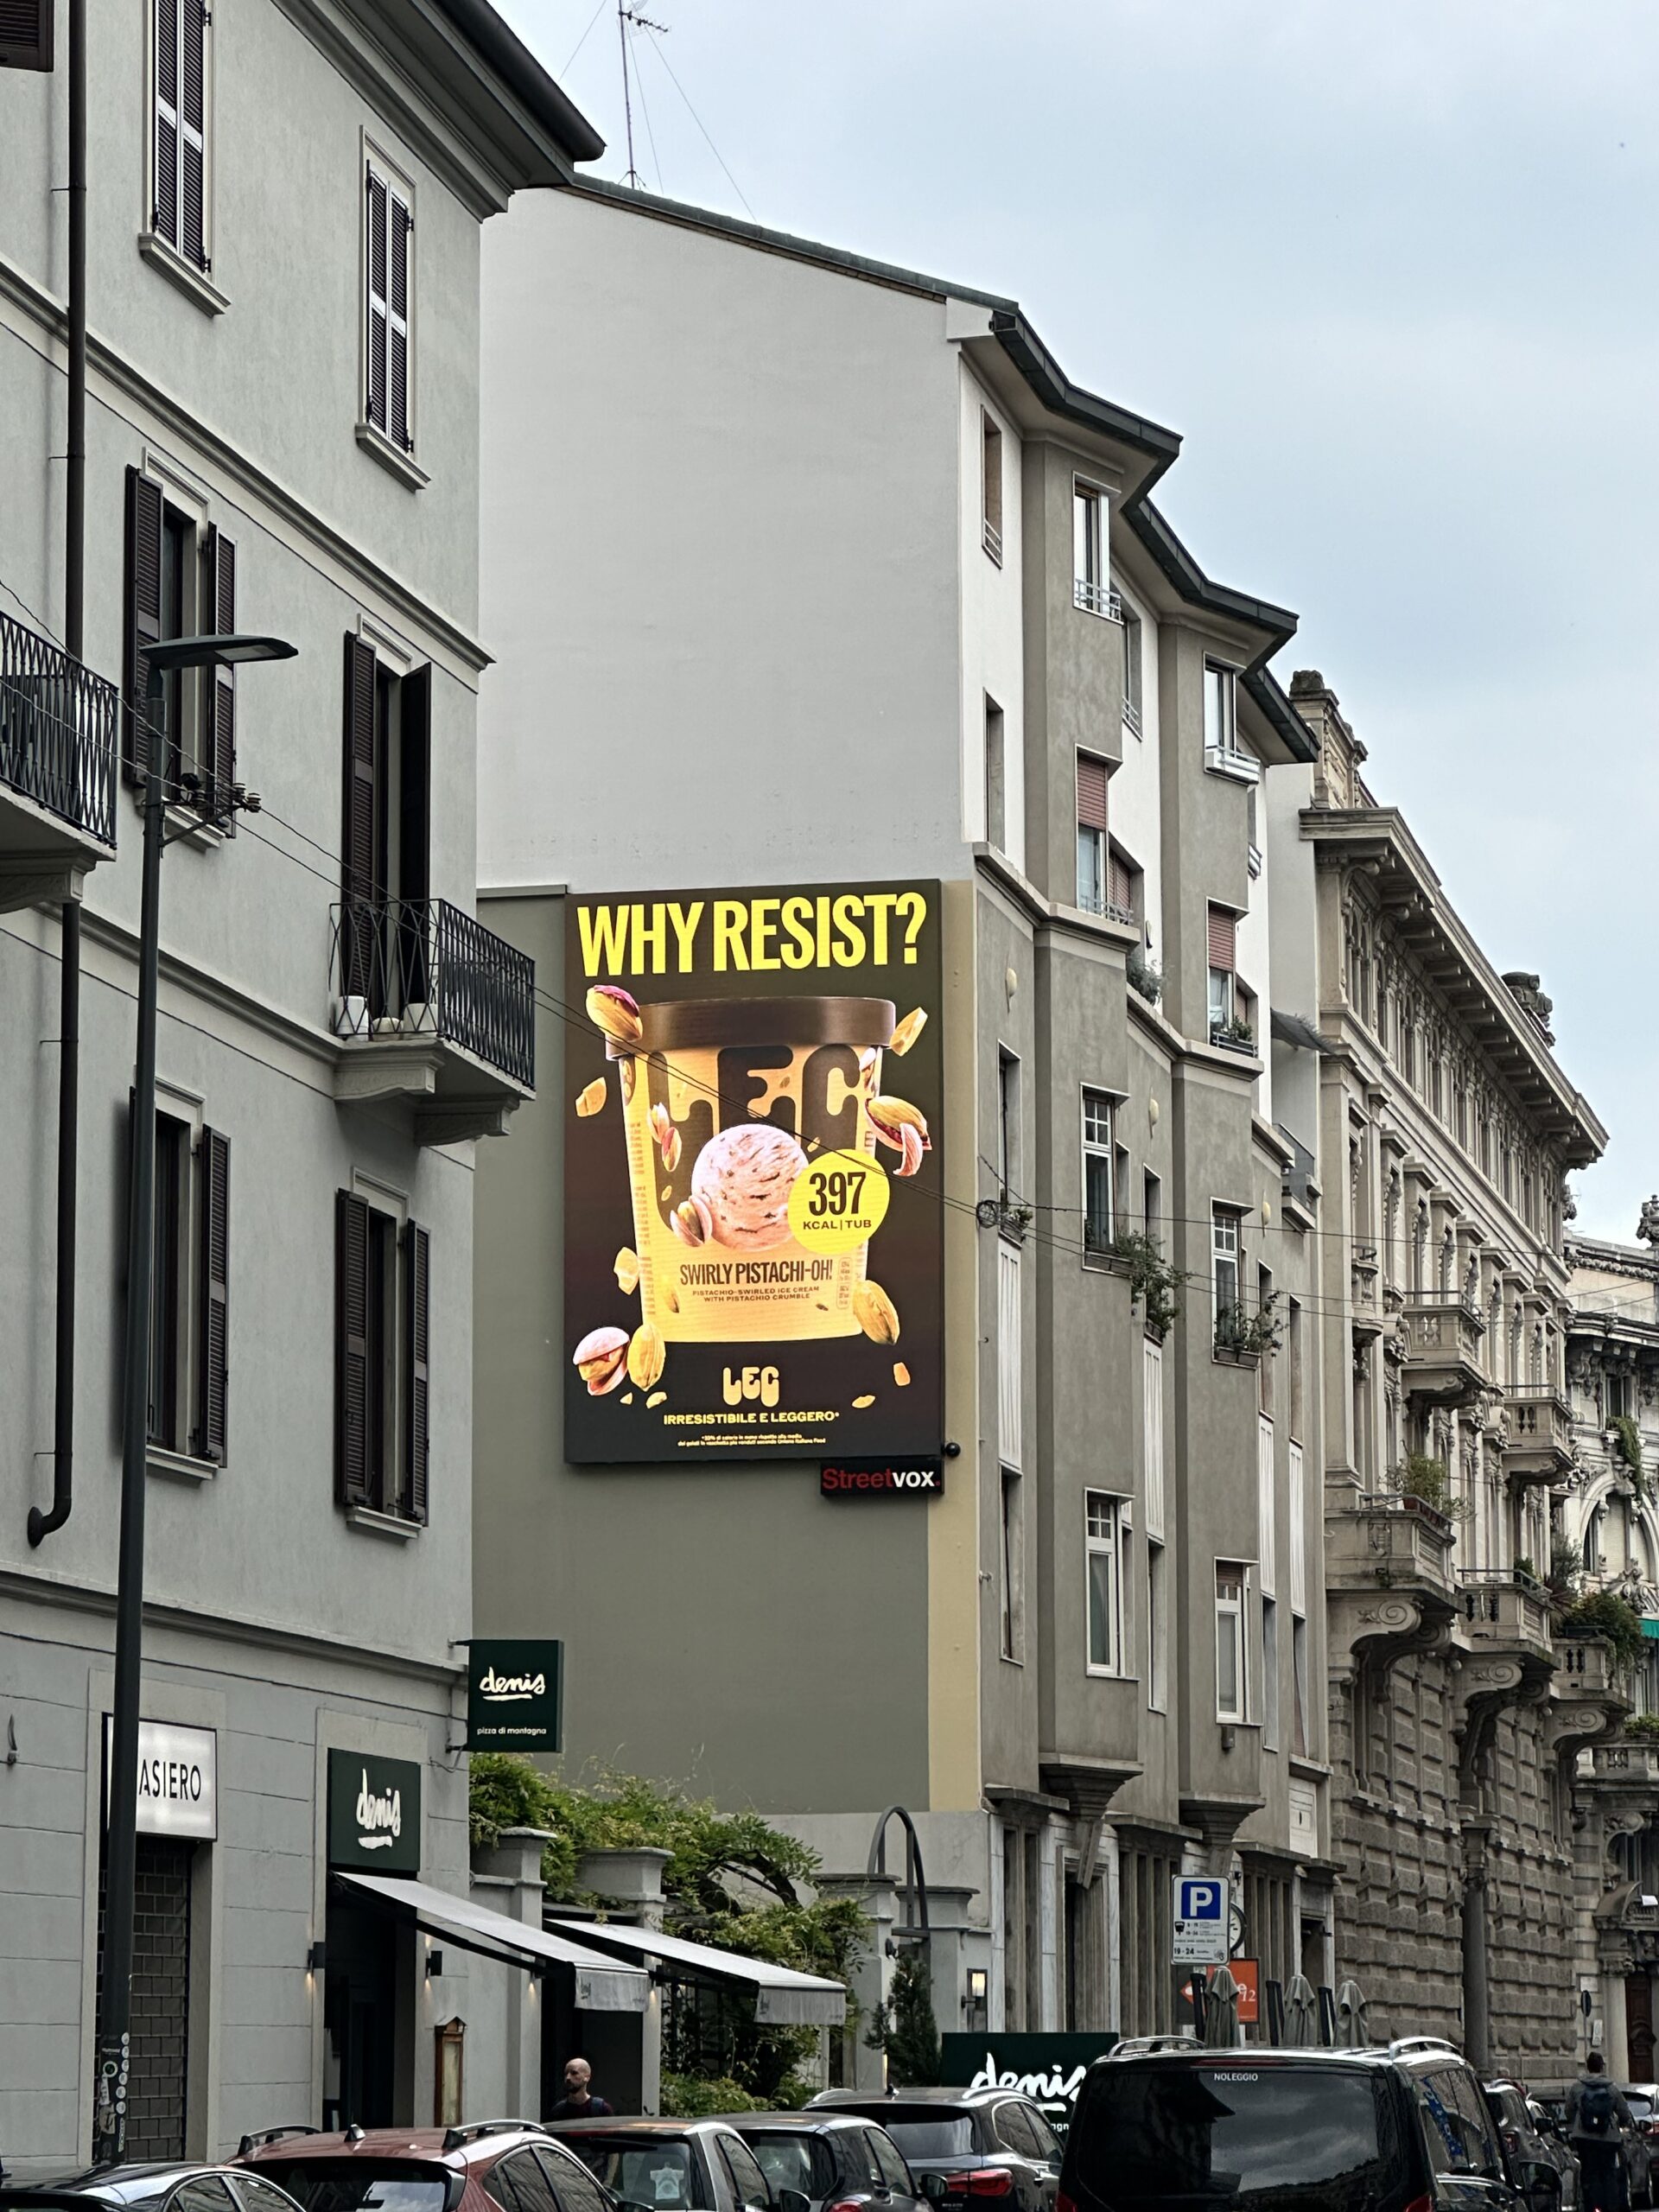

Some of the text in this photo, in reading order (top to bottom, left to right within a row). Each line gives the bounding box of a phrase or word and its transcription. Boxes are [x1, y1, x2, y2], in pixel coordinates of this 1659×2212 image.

[577, 892, 927, 976] WHY RESIST?
[809, 1172, 866, 1216] 397
[680, 1263, 733, 1286] SWIRLY
[735, 1259, 833, 1284] PISTACHI-OH!
[664, 1413, 757, 1425] IRRESISTIBILE
[760, 1413, 769, 1423] E
[480, 1667, 545, 1694] denis
[507, 1727, 547, 1736] montagna
[139, 1759, 201, 1802] ASIERO
[356, 1768, 401, 1837] denis
[1190, 1886, 1213, 1916] P
[1214, 2073, 1258, 2082] NOLEGGIO
